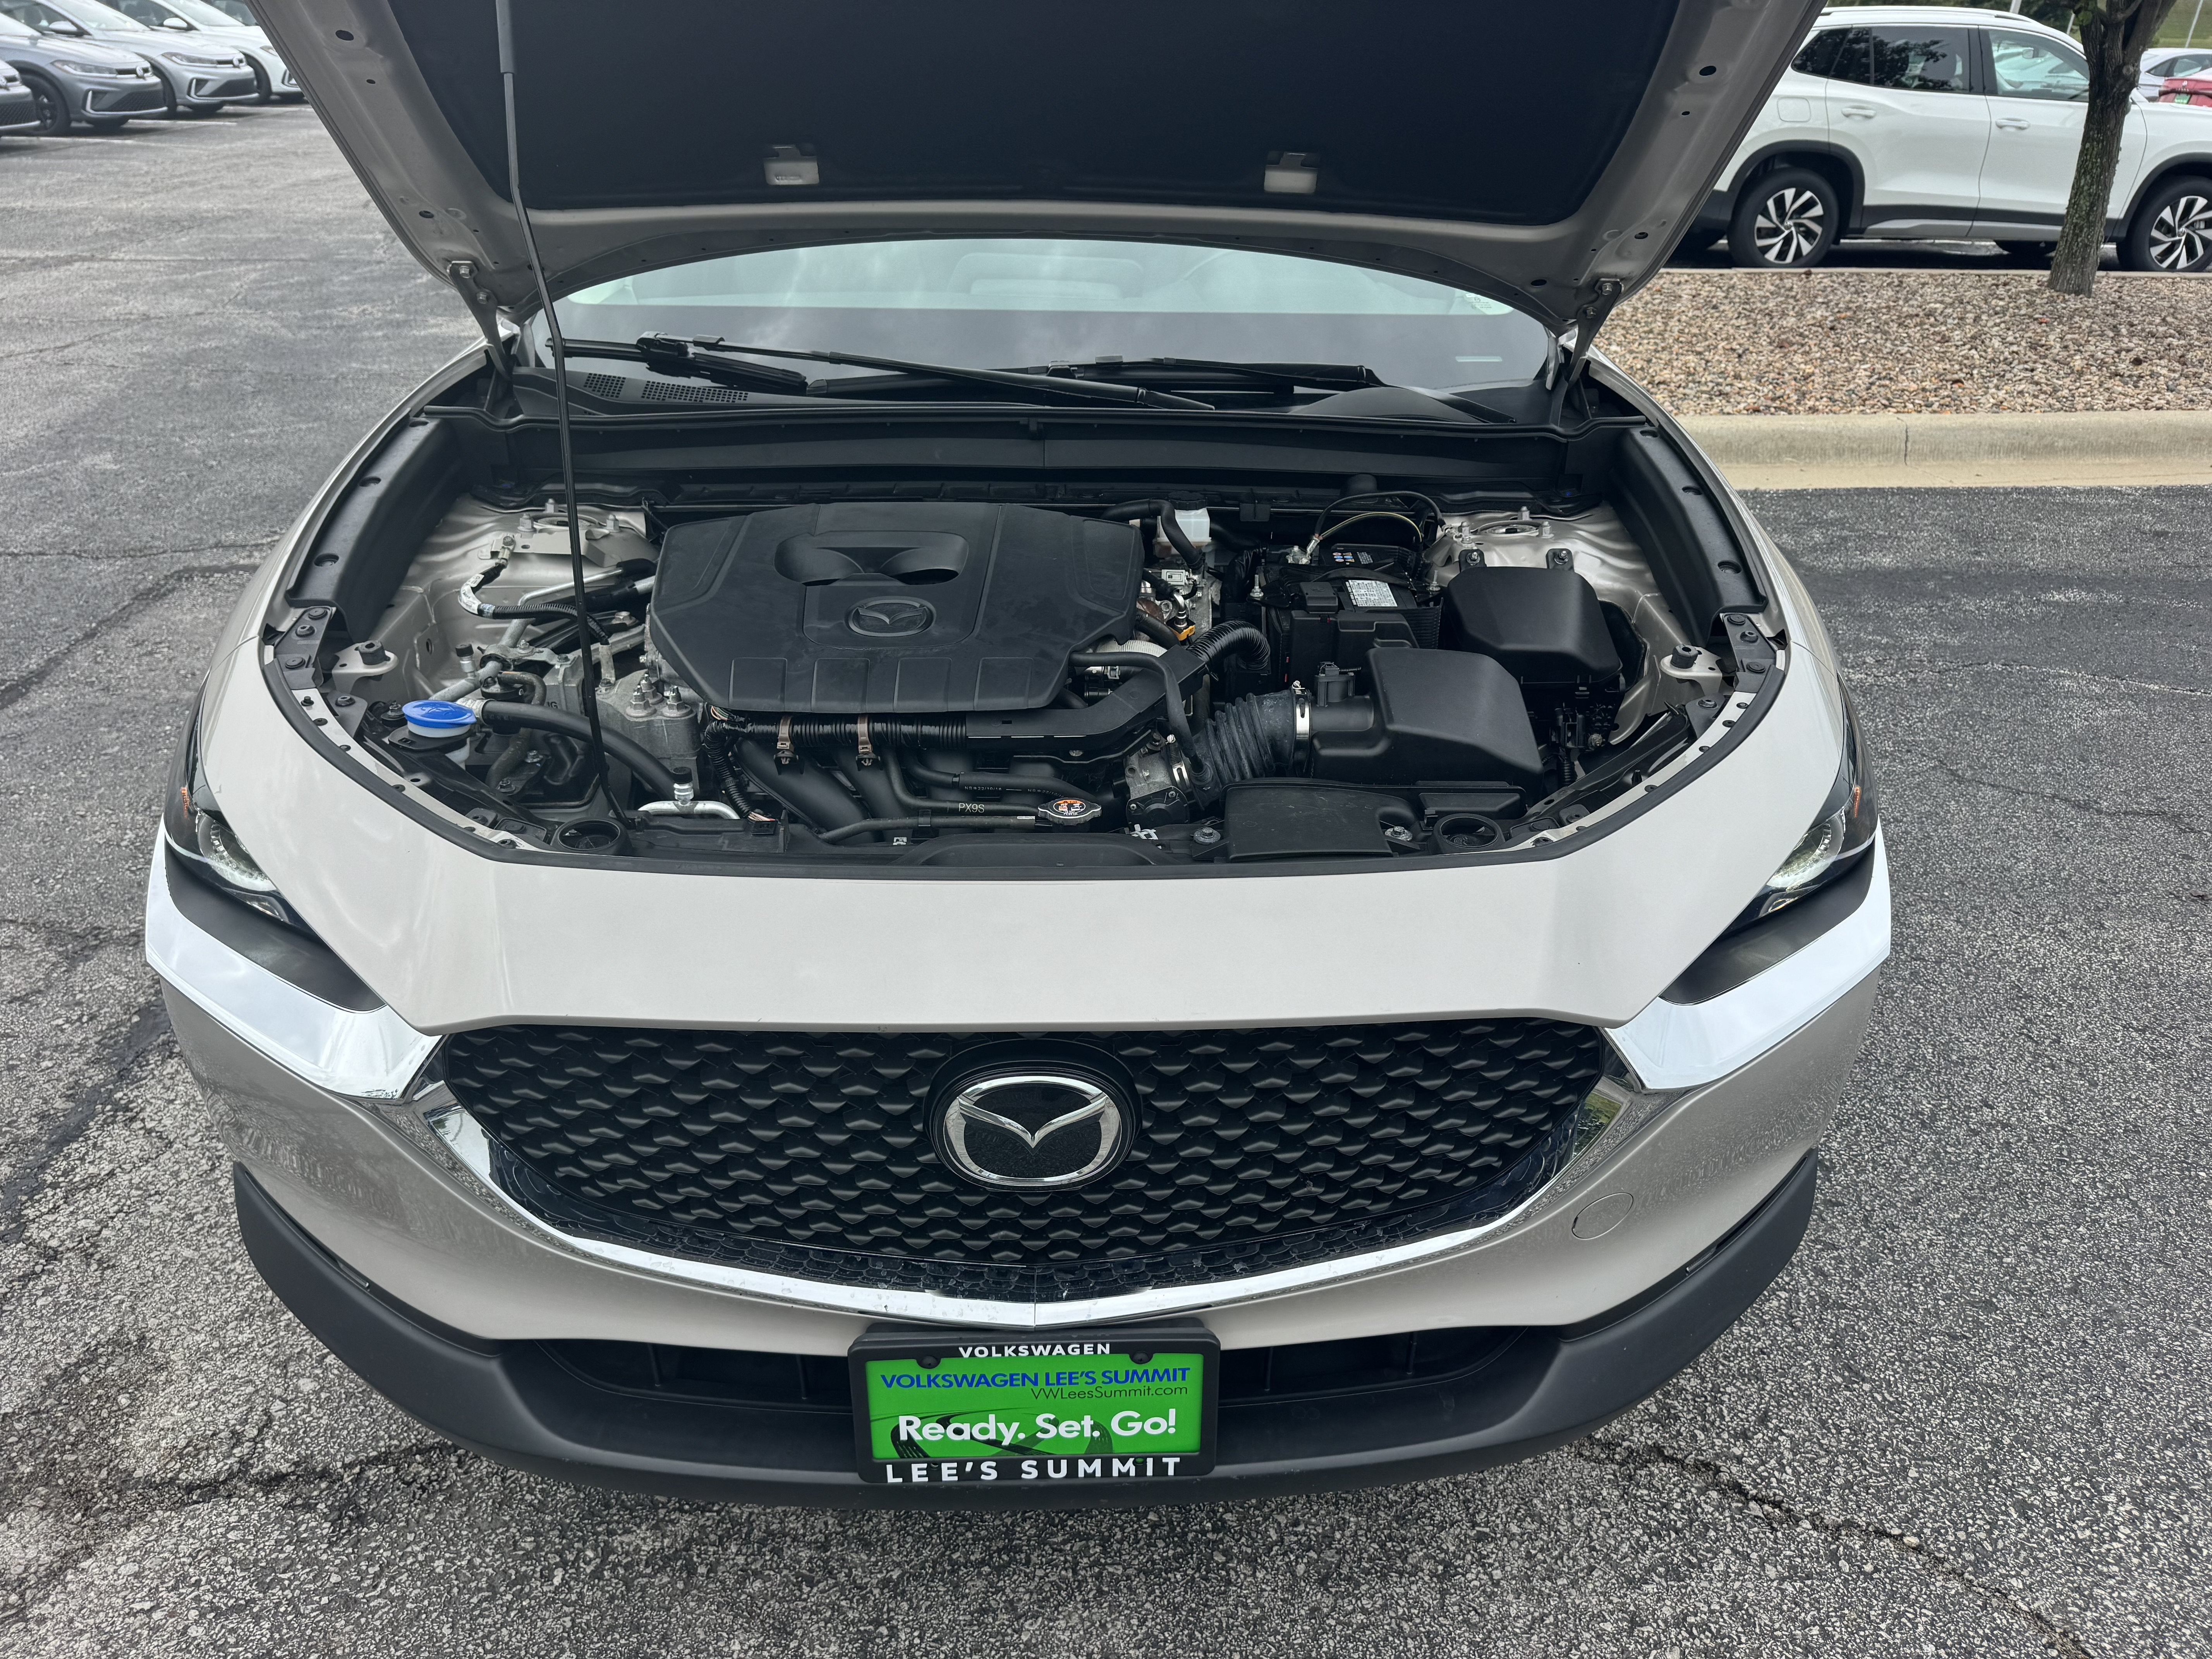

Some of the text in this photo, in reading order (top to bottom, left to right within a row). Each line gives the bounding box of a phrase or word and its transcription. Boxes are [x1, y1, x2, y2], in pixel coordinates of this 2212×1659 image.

[958, 802, 985, 813] PX9S
[958, 1343, 1110, 1358] VOLKSWAGEN
[880, 1367, 1190, 1388] VOLKSWAGEN LEE'S SUMMIT
[1031, 1385, 1188, 1400] VWLeesSummit.com
[898, 1408, 1176, 1446] Ready. Set. Go!
[886, 1457, 1180, 1483] LEE'S SUMMIT
